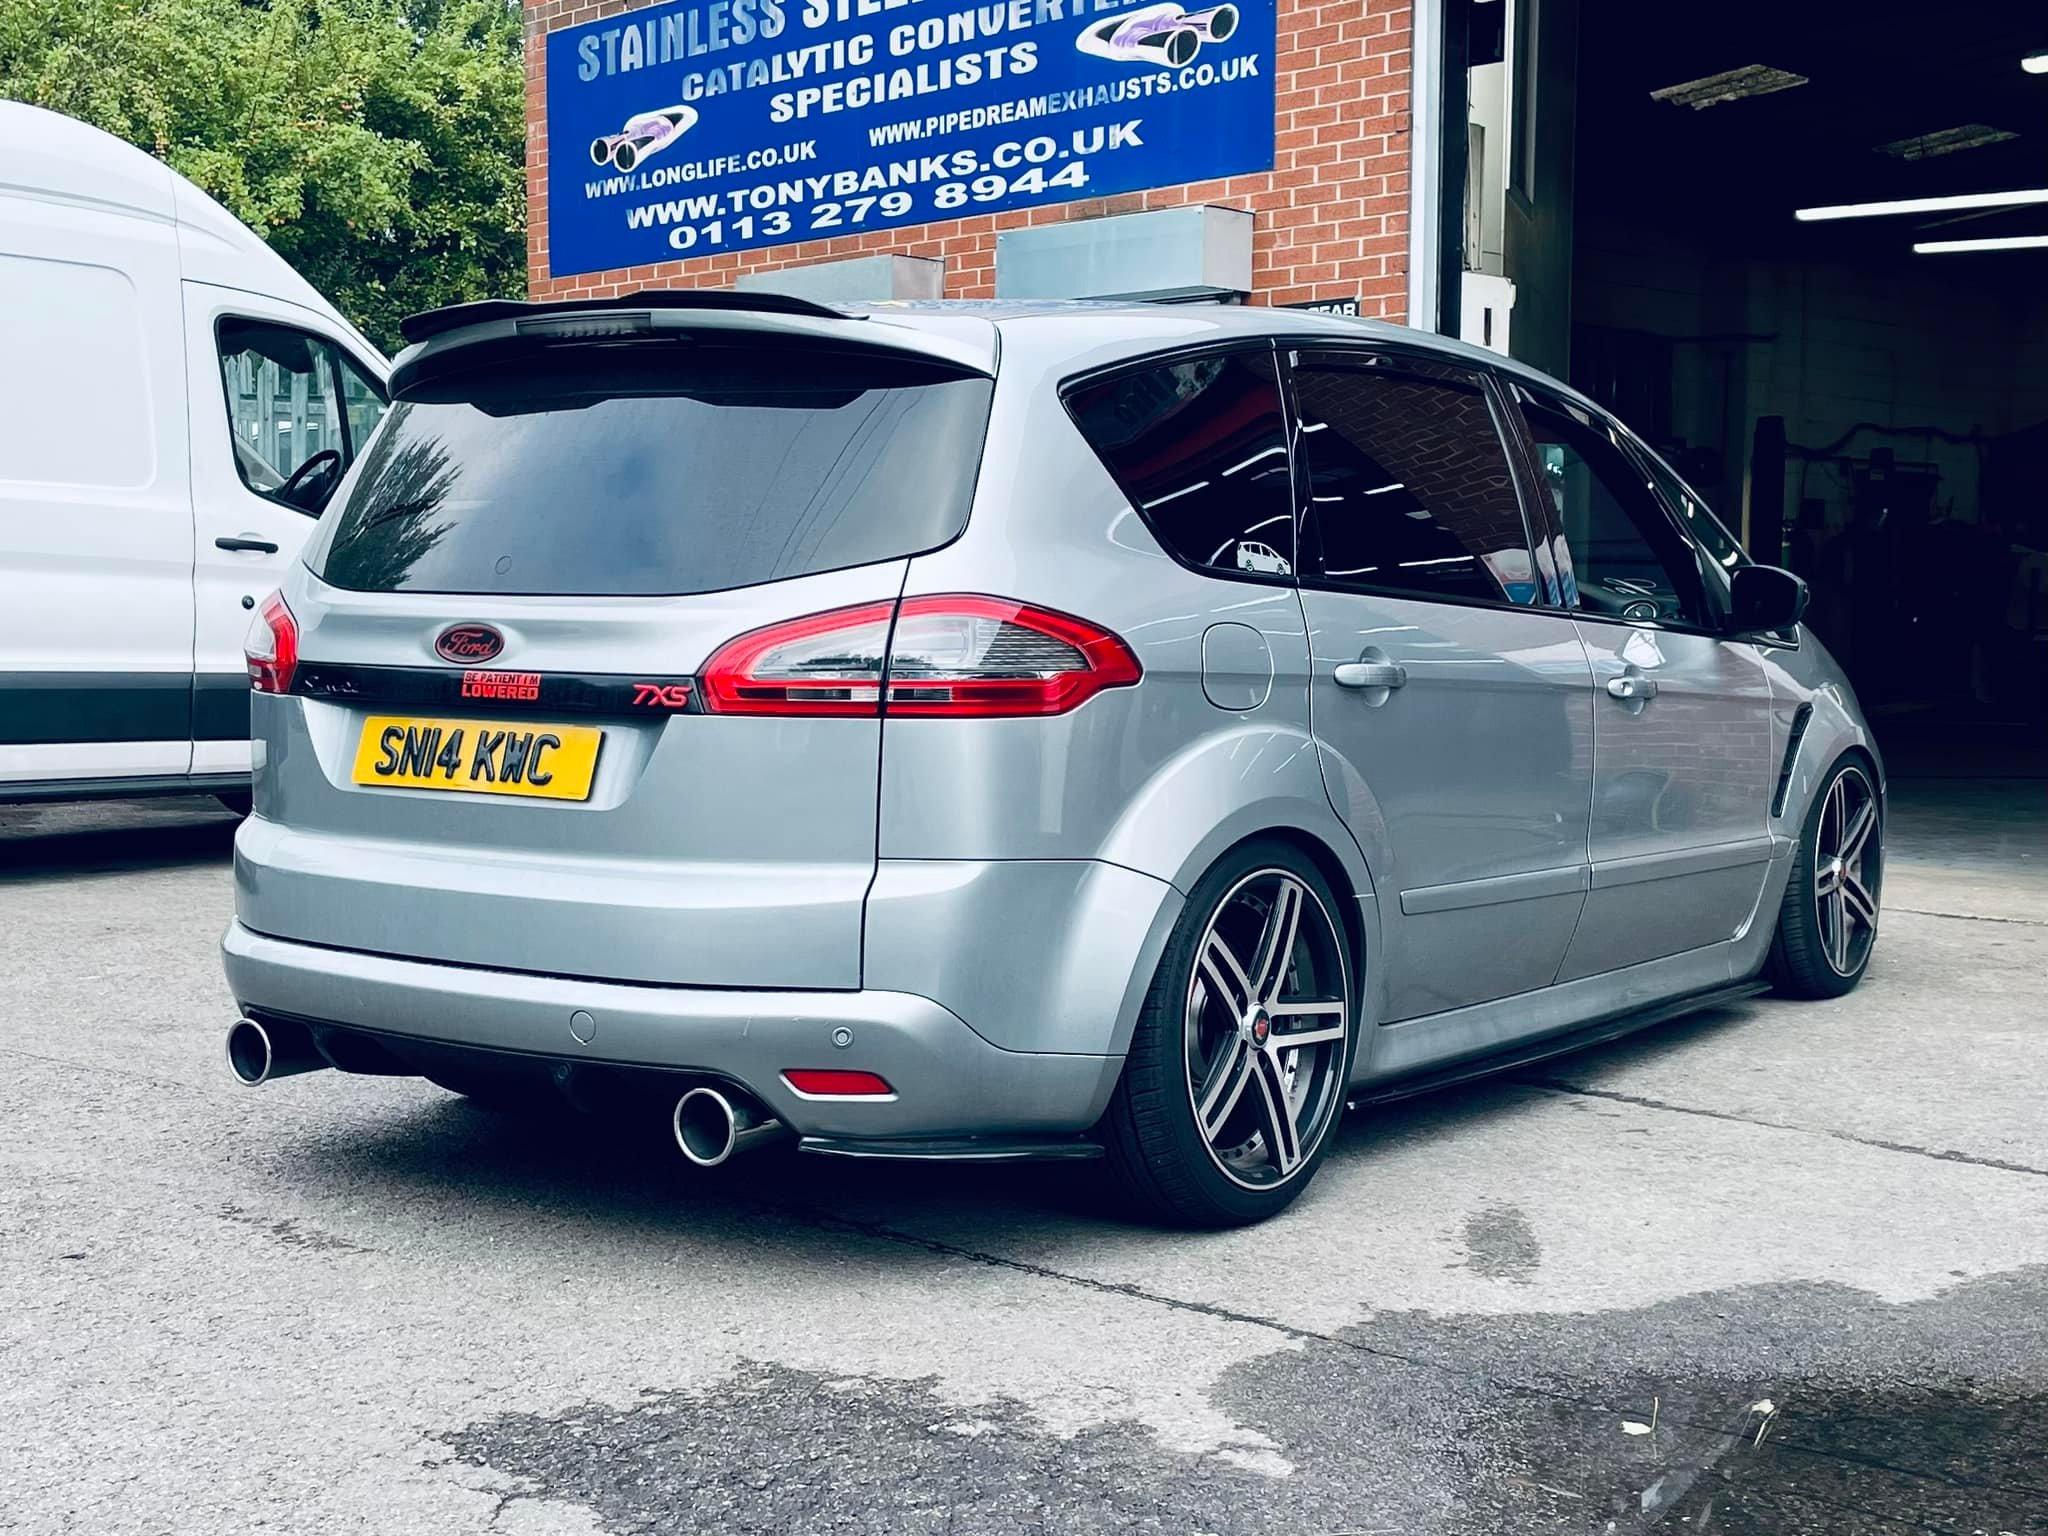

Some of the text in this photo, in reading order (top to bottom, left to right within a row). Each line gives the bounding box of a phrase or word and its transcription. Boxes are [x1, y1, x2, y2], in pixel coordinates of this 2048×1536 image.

[578, 0, 785, 82] STAINLESS
[682, 34, 873, 101] CATALYTIC
[770, 42, 1038, 123] SPECIALISTS
[869, 54, 1259, 147] WWW.PIPEDREAMEXHAUSTS.CO.UK
[585, 140, 816, 199] WWW.LONGLIFE.CO.UK
[626, 119, 1144, 230] WWW.TONYBANKS.CO.UK
[669, 161, 1090, 250] 0113 279 8944
[445, 631, 496, 657] Ford
[462, 684, 539, 699] LOWERED
[465, 672, 479, 682] BE
[480, 673, 521, 684] PATIENT
[375, 726, 561, 785] SN14 KWC
